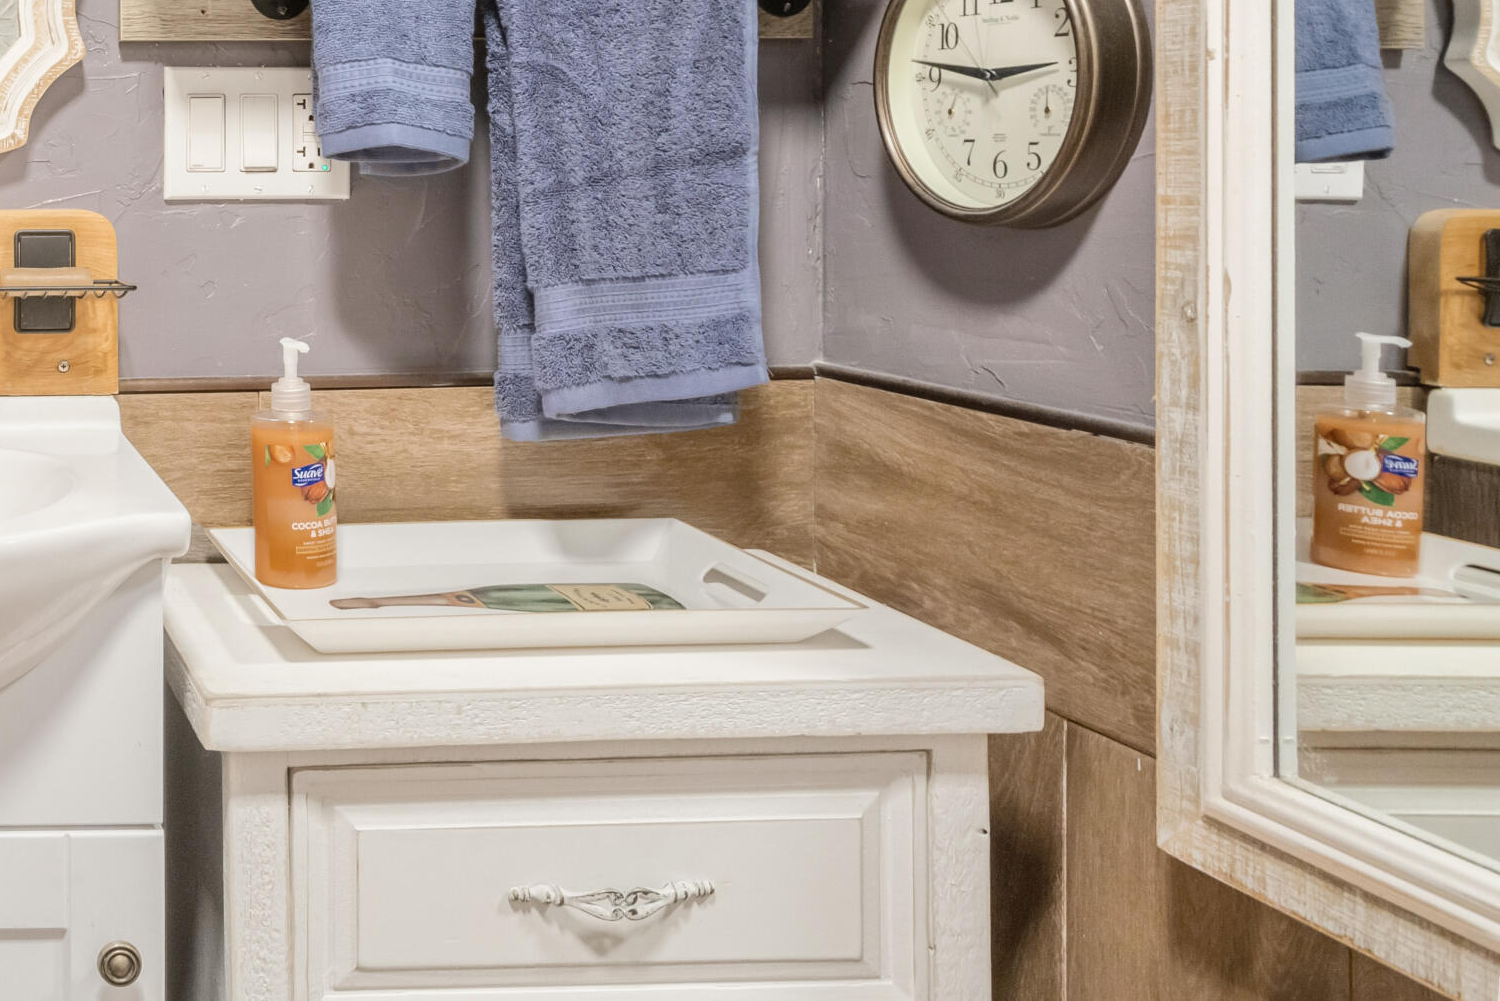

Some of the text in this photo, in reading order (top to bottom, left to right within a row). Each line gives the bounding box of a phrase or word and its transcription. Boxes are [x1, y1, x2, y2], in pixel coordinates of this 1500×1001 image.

[938, 22, 959, 50] 10
[1054, 7, 1070, 37] 2
[929, 65, 941, 92] 9
[962, 139, 976, 167] 7
[992, 150, 1008, 179] 6
[1027, 141, 1041, 171] 5
[293, 466, 324, 480] Suave
[291, 520, 323, 530] COCOA
